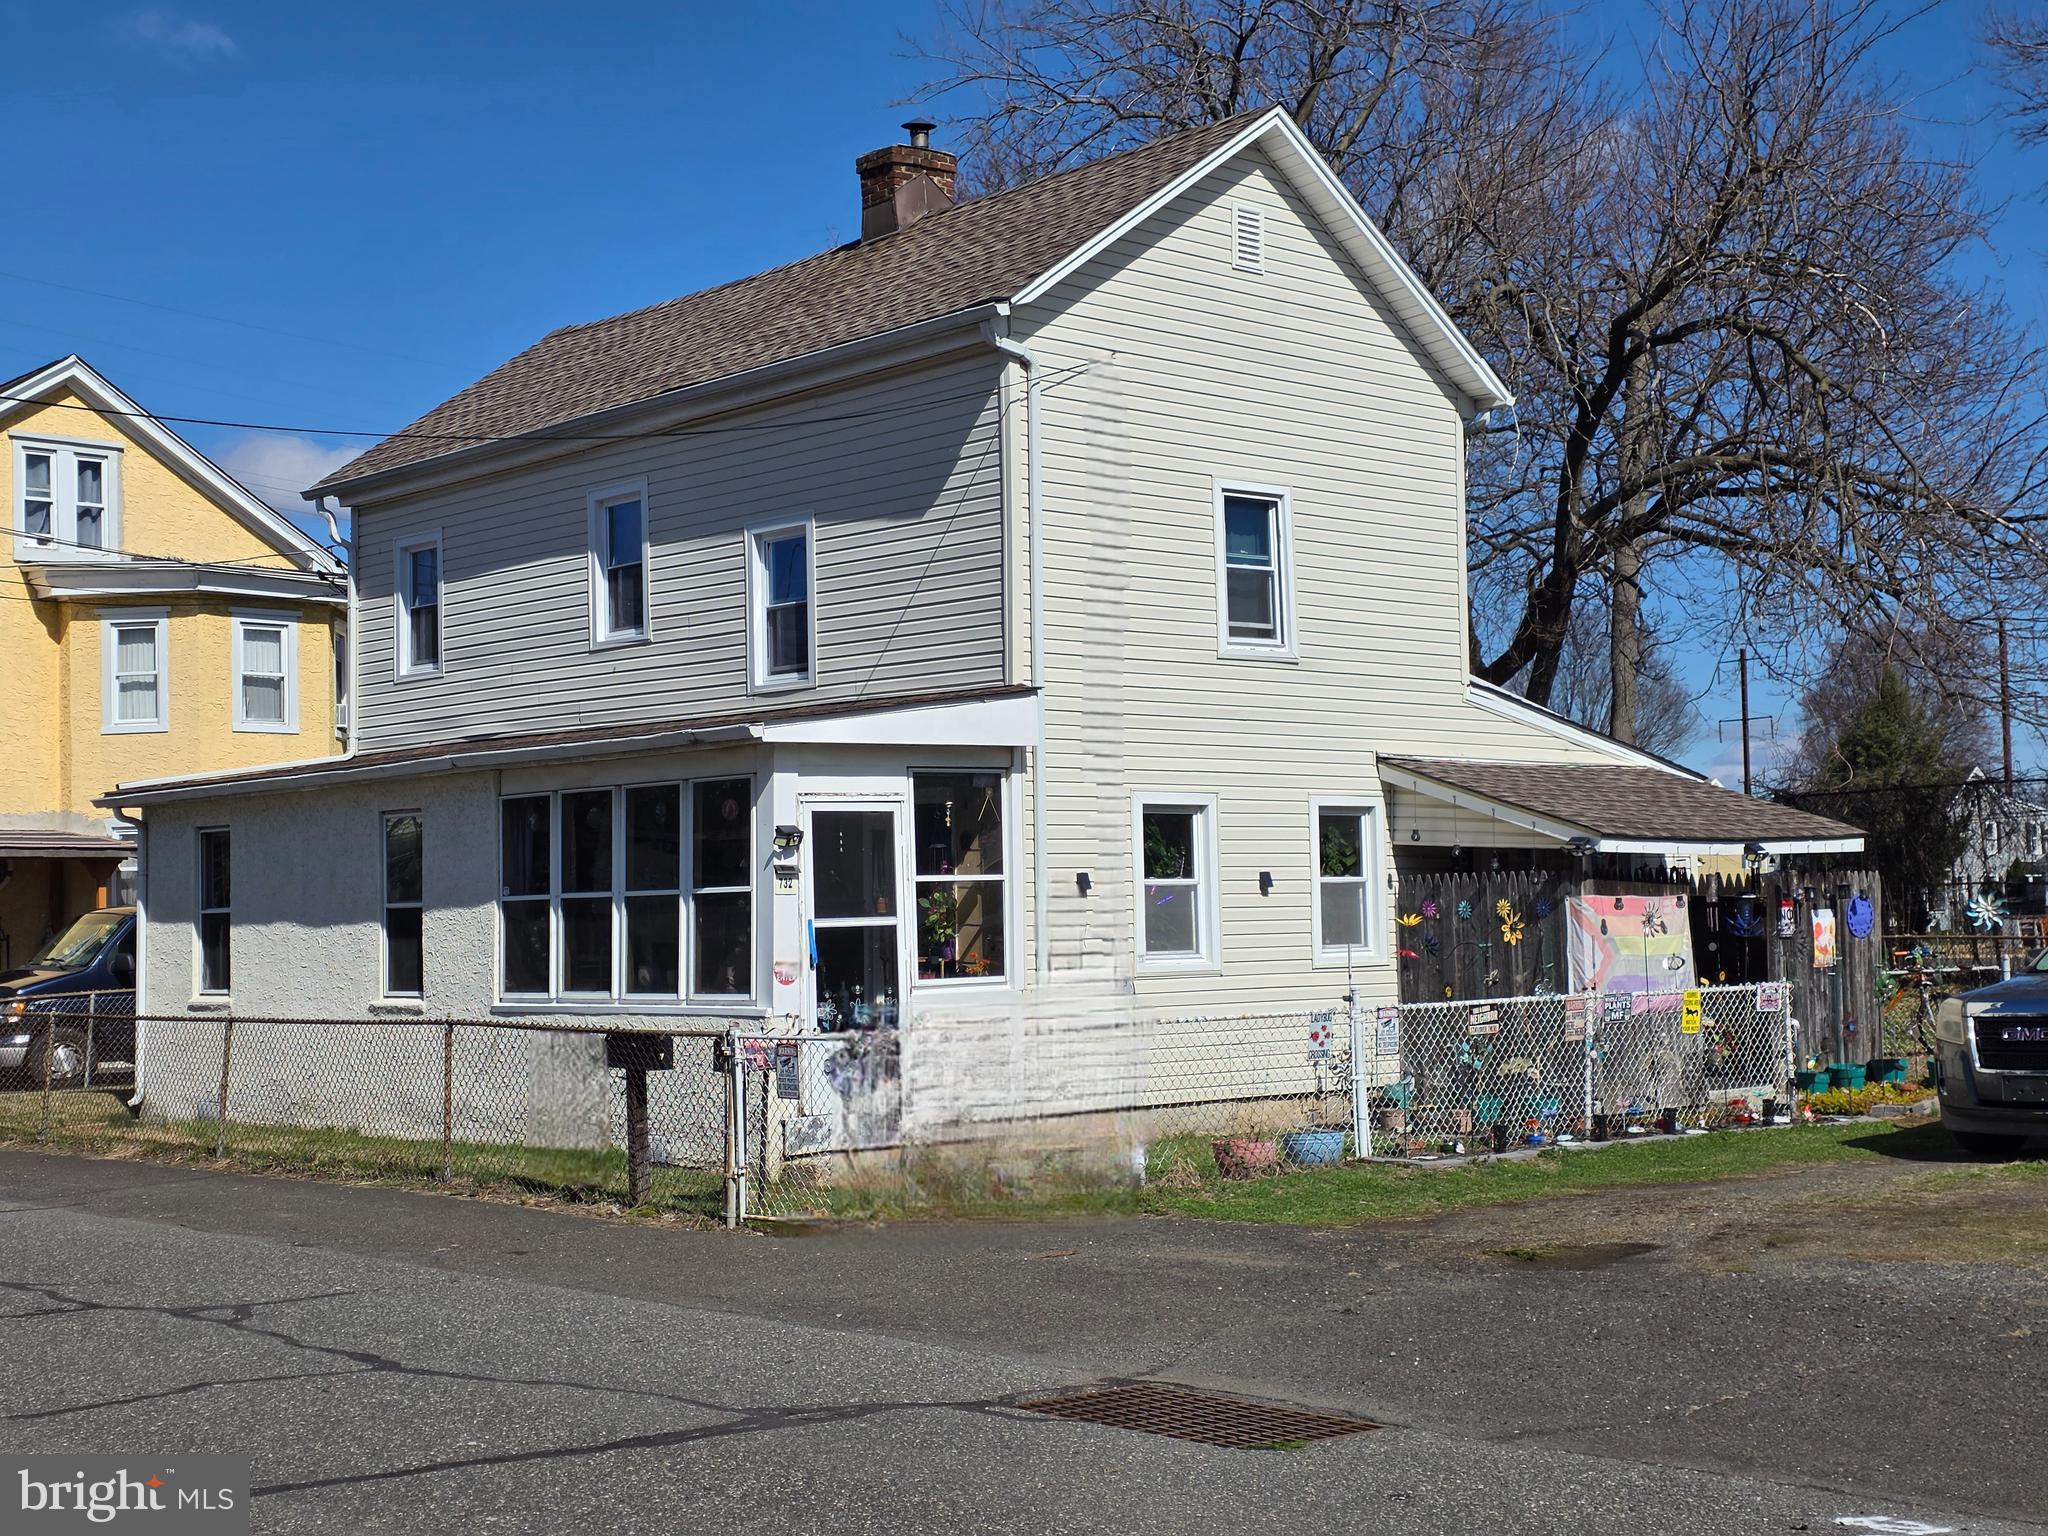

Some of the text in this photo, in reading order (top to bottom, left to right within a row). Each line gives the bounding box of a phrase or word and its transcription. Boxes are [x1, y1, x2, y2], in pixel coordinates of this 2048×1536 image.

[778, 877, 793, 889] 732
[1604, 1001, 1631, 1010] PLANTS
[1310, 1012, 1333, 1023] LADYBUG
[1611, 1011, 1625, 1020] MF
[2002, 1026, 2048, 1041] GMC
[1308, 1048, 1331, 1059] CROSSING
